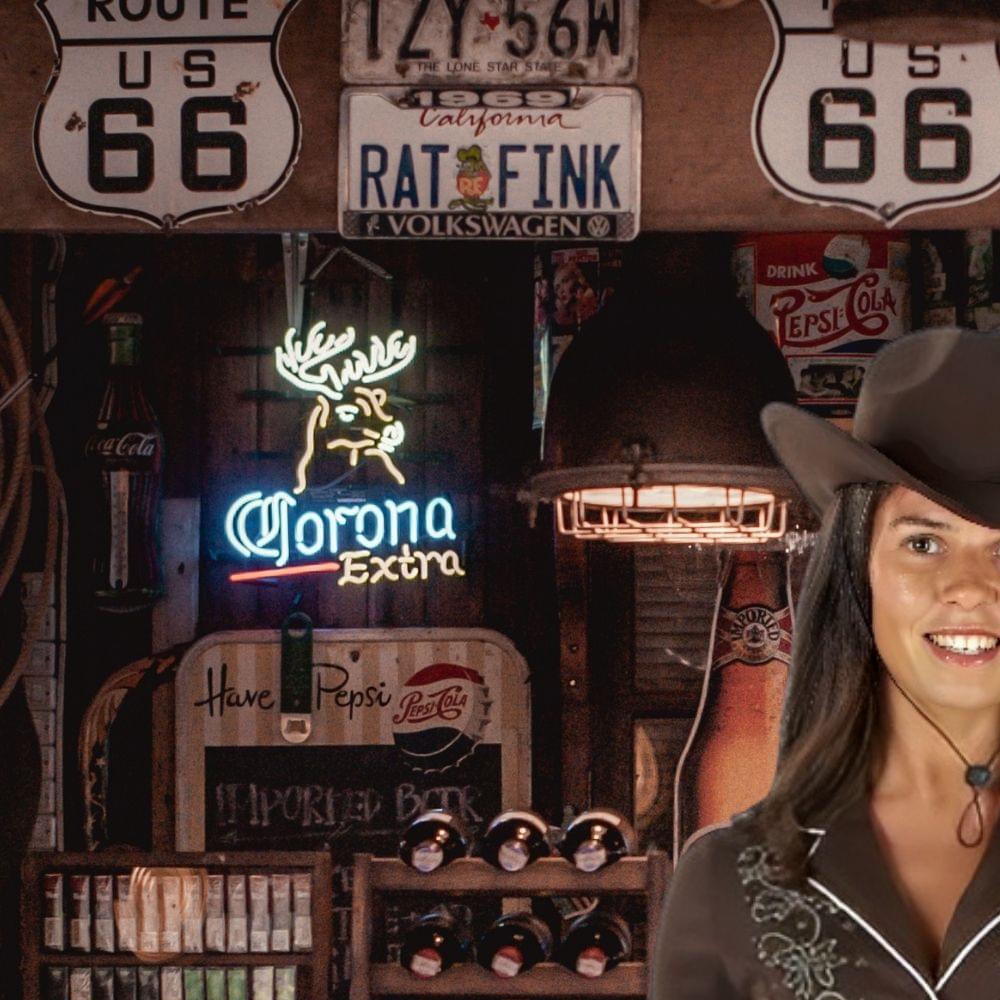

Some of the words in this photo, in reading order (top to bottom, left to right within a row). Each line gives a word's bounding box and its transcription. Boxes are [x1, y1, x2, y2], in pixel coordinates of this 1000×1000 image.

[416, 61, 440, 73] THE
[446, 61, 480, 73] LONE
[486, 61, 518, 73] STAR
[524, 61, 564, 73] STATE
[413, 89, 561, 108] 1969
[419, 106, 581, 137] California
[807, 87, 973, 184] 66
[87, 95, 248, 194] 66
[360, 144, 449, 208] RAT
[499, 144, 621, 208] FINK
[388, 214, 581, 237] VOLKSWAGEN
[766, 261, 818, 279] DRINK
[225, 490, 457, 567] Corona
[337, 543, 466, 586] Extra
[194, 663, 275, 717] Have
[311, 662, 392, 720] Pepsi
